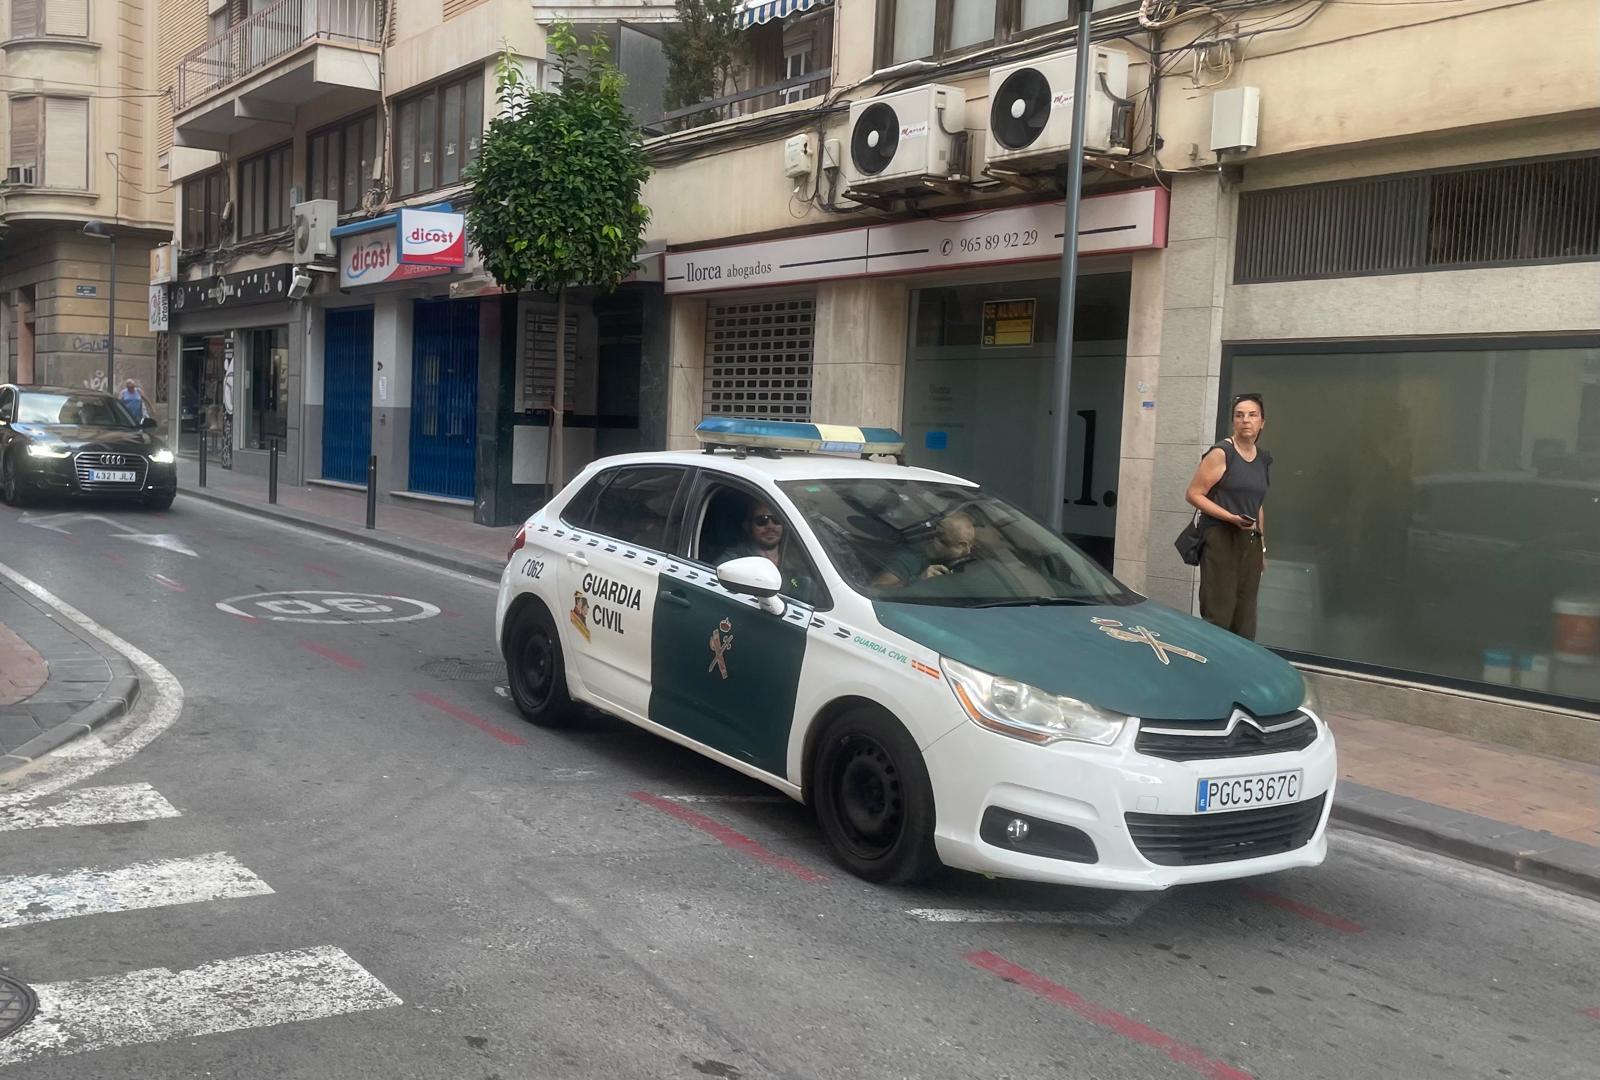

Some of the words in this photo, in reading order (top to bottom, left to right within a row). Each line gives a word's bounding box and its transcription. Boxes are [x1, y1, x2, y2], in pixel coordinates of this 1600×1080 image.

[411, 228, 453, 243] dicost
[960, 237, 981, 253] 965
[985, 234, 1000, 250] 89
[1003, 232, 1019, 248] 92
[1022, 229, 1038, 246] 29
[351, 241, 391, 271] dicost
[686, 262, 721, 282] llorca
[726, 260, 772, 279] abogados
[95, 472, 116, 480] 4321
[526, 559, 545, 579] 062
[582, 573, 641, 611] GUARDIA
[592, 604, 625, 635] CIVIL
[853, 635, 887, 655] GUARDIA
[888, 650, 909, 664] CIVIL
[1208, 774, 1298, 807] PGC5367C
